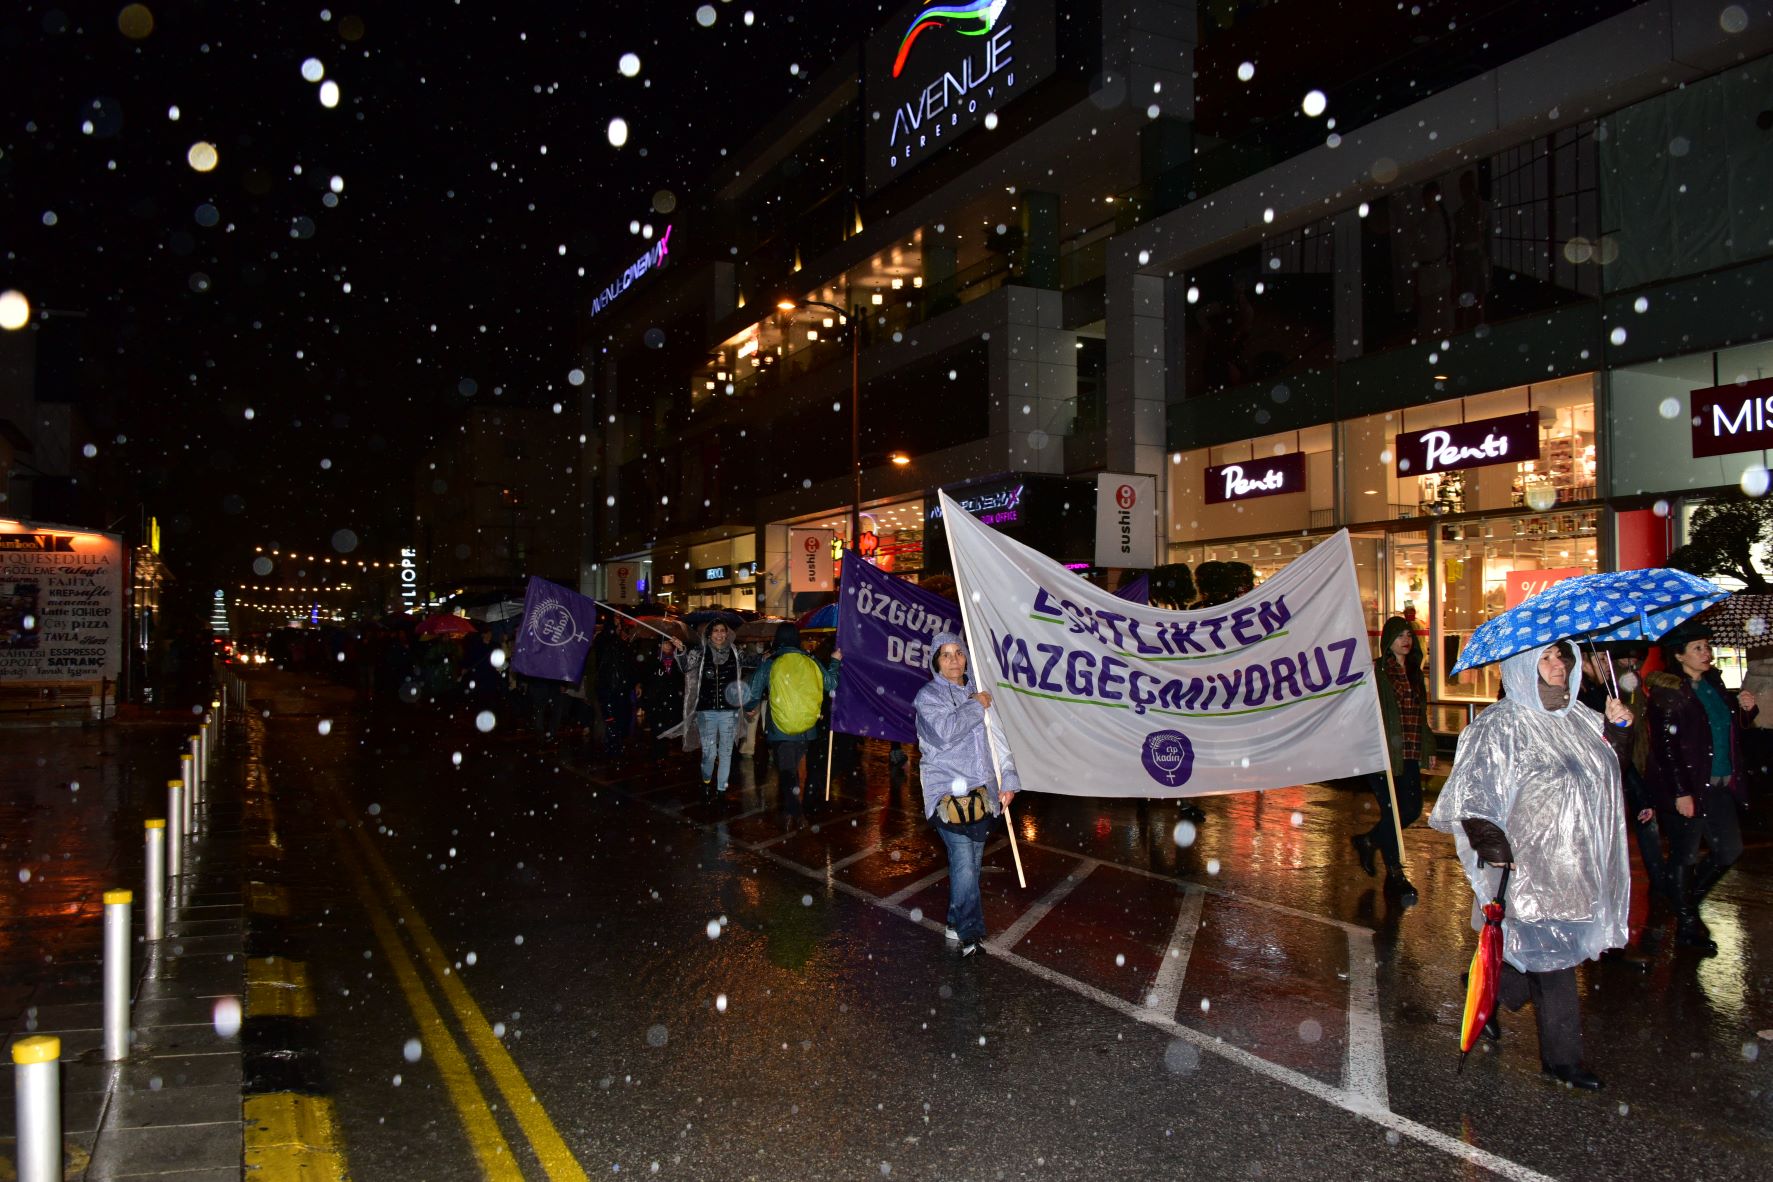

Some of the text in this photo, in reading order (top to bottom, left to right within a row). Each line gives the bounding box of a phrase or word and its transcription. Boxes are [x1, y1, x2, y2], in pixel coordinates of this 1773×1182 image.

[890, 24, 1012, 147] AVENUE
[1419, 430, 1508, 471] Penti
[1221, 465, 1284, 499] Penti
[995, 510, 1018, 524] OFFICE
[8, 553, 110, 566] QUESEDILLA
[45, 632, 79, 642] TAVLA
[50, 648, 106, 657] ESSPRESSO
[47, 657, 105, 668] SATRANÇ
